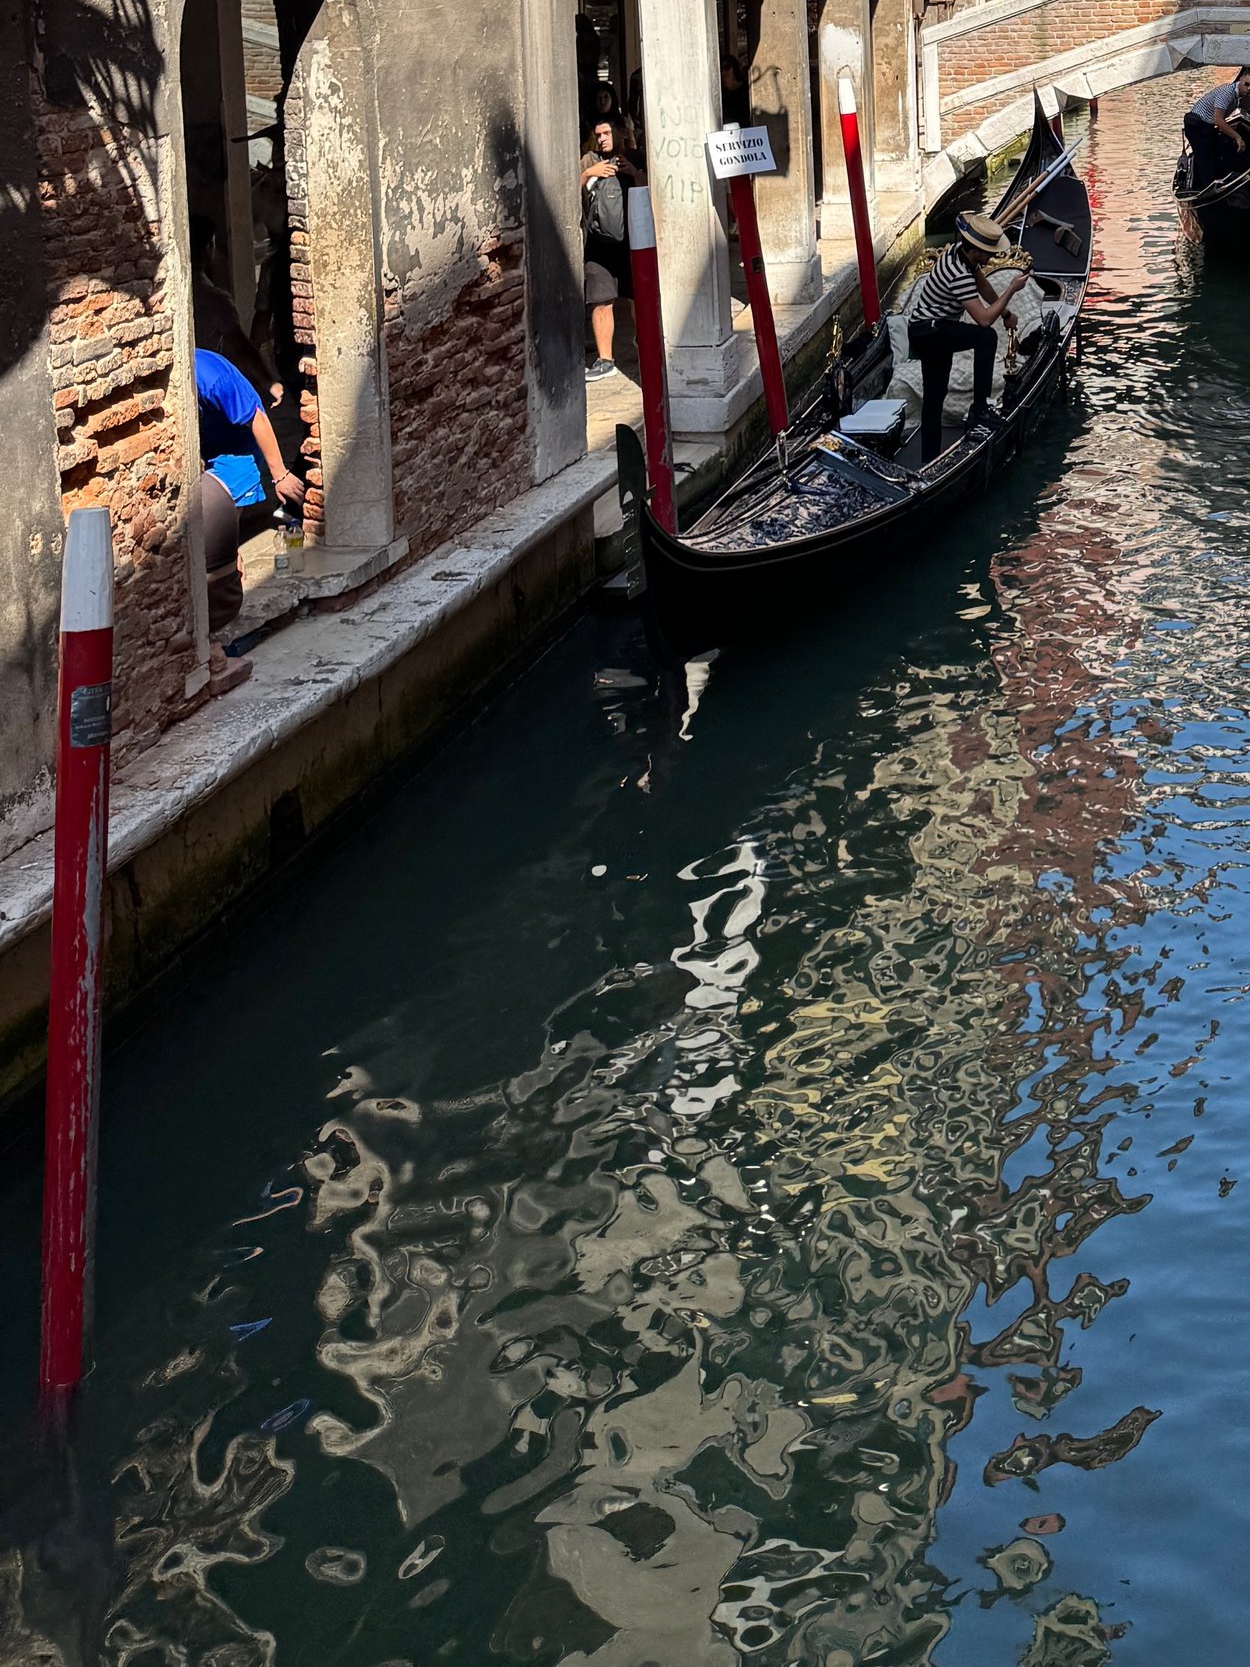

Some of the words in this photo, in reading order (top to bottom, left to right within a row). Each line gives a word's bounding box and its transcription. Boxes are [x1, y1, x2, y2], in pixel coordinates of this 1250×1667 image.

[654, 136, 704, 159] VOTO
[715, 138, 763, 152] SERVIZIO
[719, 152, 767, 165] GONDOLA
